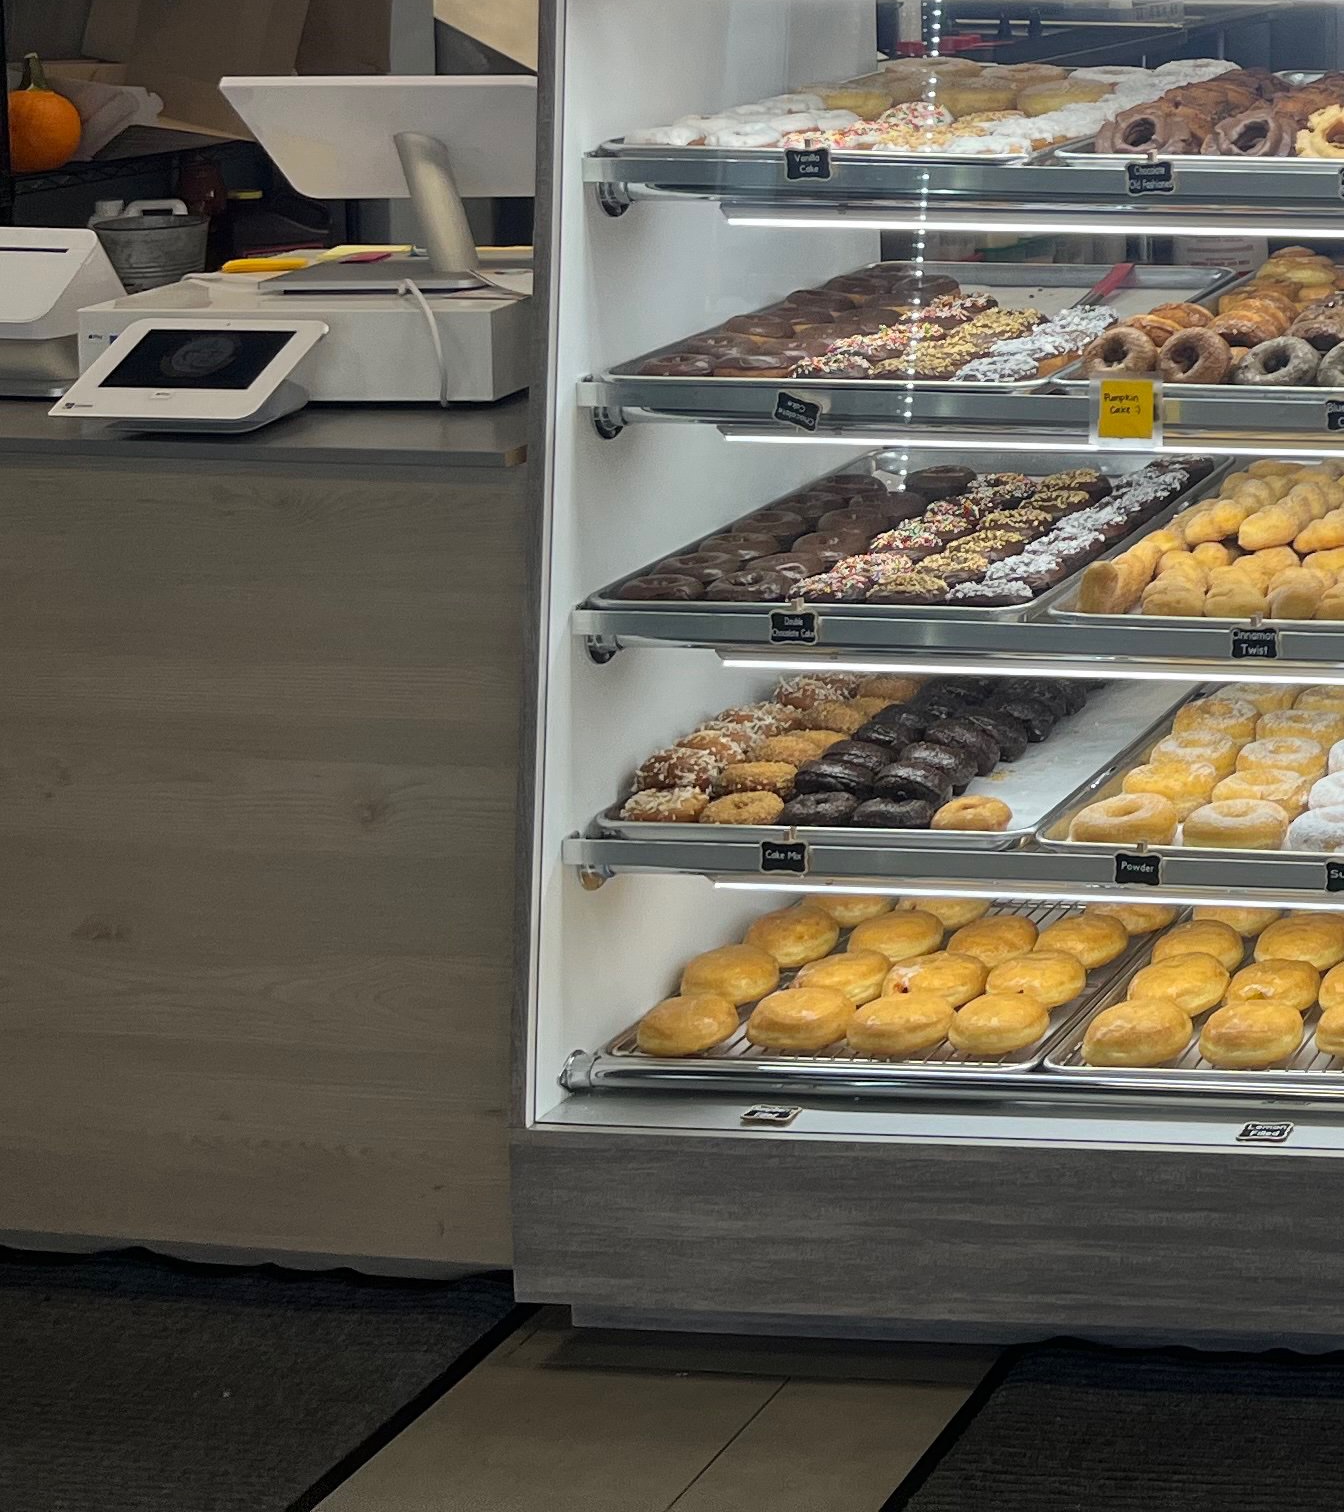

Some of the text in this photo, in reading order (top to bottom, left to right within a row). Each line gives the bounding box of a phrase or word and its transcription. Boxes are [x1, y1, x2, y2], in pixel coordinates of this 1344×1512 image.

[794, 153, 820, 163] Vanilla
[800, 165, 819, 174] Cake
[1134, 165, 1166, 176] Chocolate
[1129, 179, 1174, 191] Old Fashioned
[1103, 392, 1139, 404] Pumpkin
[1109, 405, 1131, 415] Cake
[783, 617, 804, 626] Double
[772, 629, 800, 638] Chocolate
[1231, 629, 1277, 640] Cinnamon
[1240, 643, 1269, 655] Twist
[765, 849, 802, 861] Cake Mix
[1120, 860, 1155, 873] Powder
